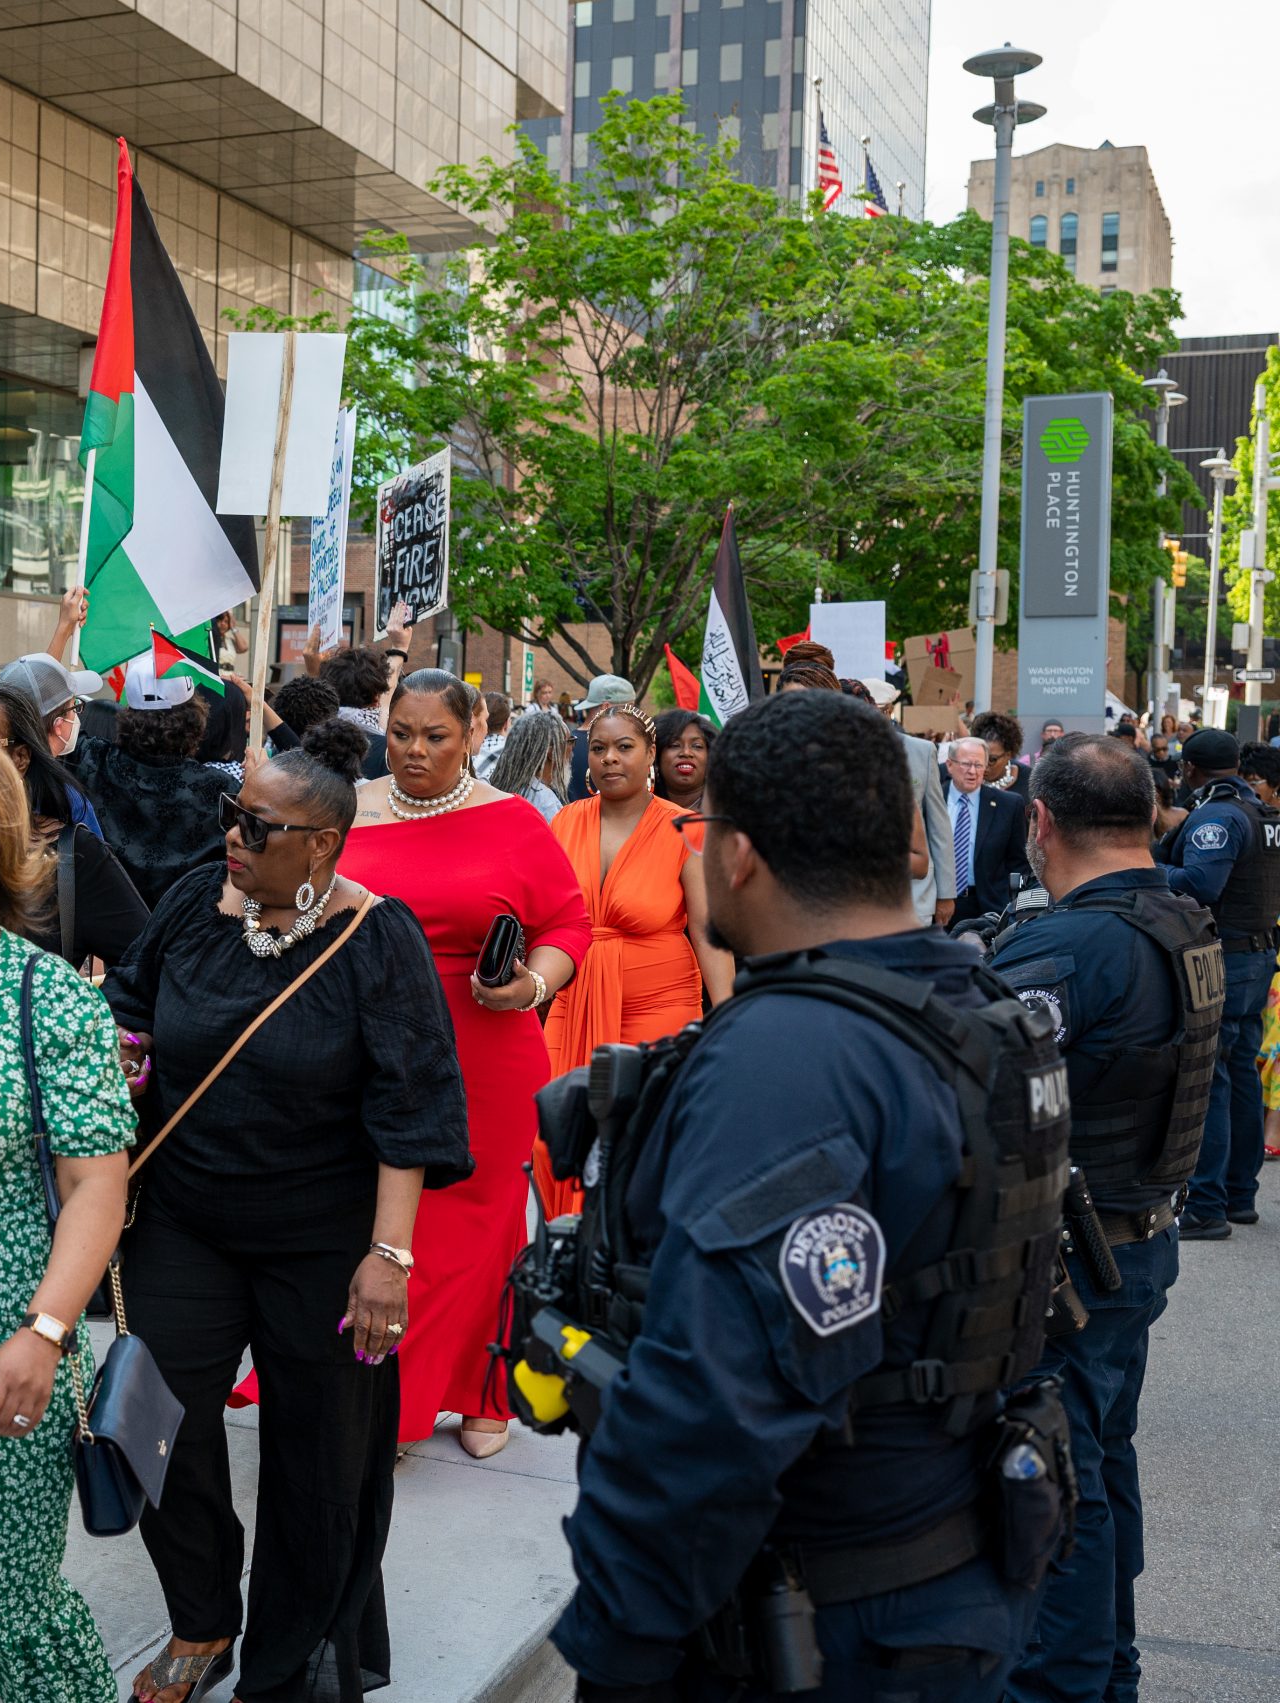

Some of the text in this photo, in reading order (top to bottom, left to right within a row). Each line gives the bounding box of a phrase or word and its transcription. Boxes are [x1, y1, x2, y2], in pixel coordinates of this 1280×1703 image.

[1046, 472, 1060, 529] PLACE
[394, 492, 446, 542] CEASE
[1065, 471, 1080, 597] HUNTINGTON
[393, 539, 440, 593] FIRE
[1028, 666, 1094, 675] WASHINGTON
[1031, 676, 1090, 685] BOULEVARD
[1043, 686, 1078, 695] NORTH
[1196, 825, 1224, 837] DETROIT
[1036, 989, 1061, 1005] POLICE
[1053, 1026, 1068, 1043] ORCE
[788, 1212, 871, 1268] DETROIT
[821, 1291, 872, 1326] POLICE
